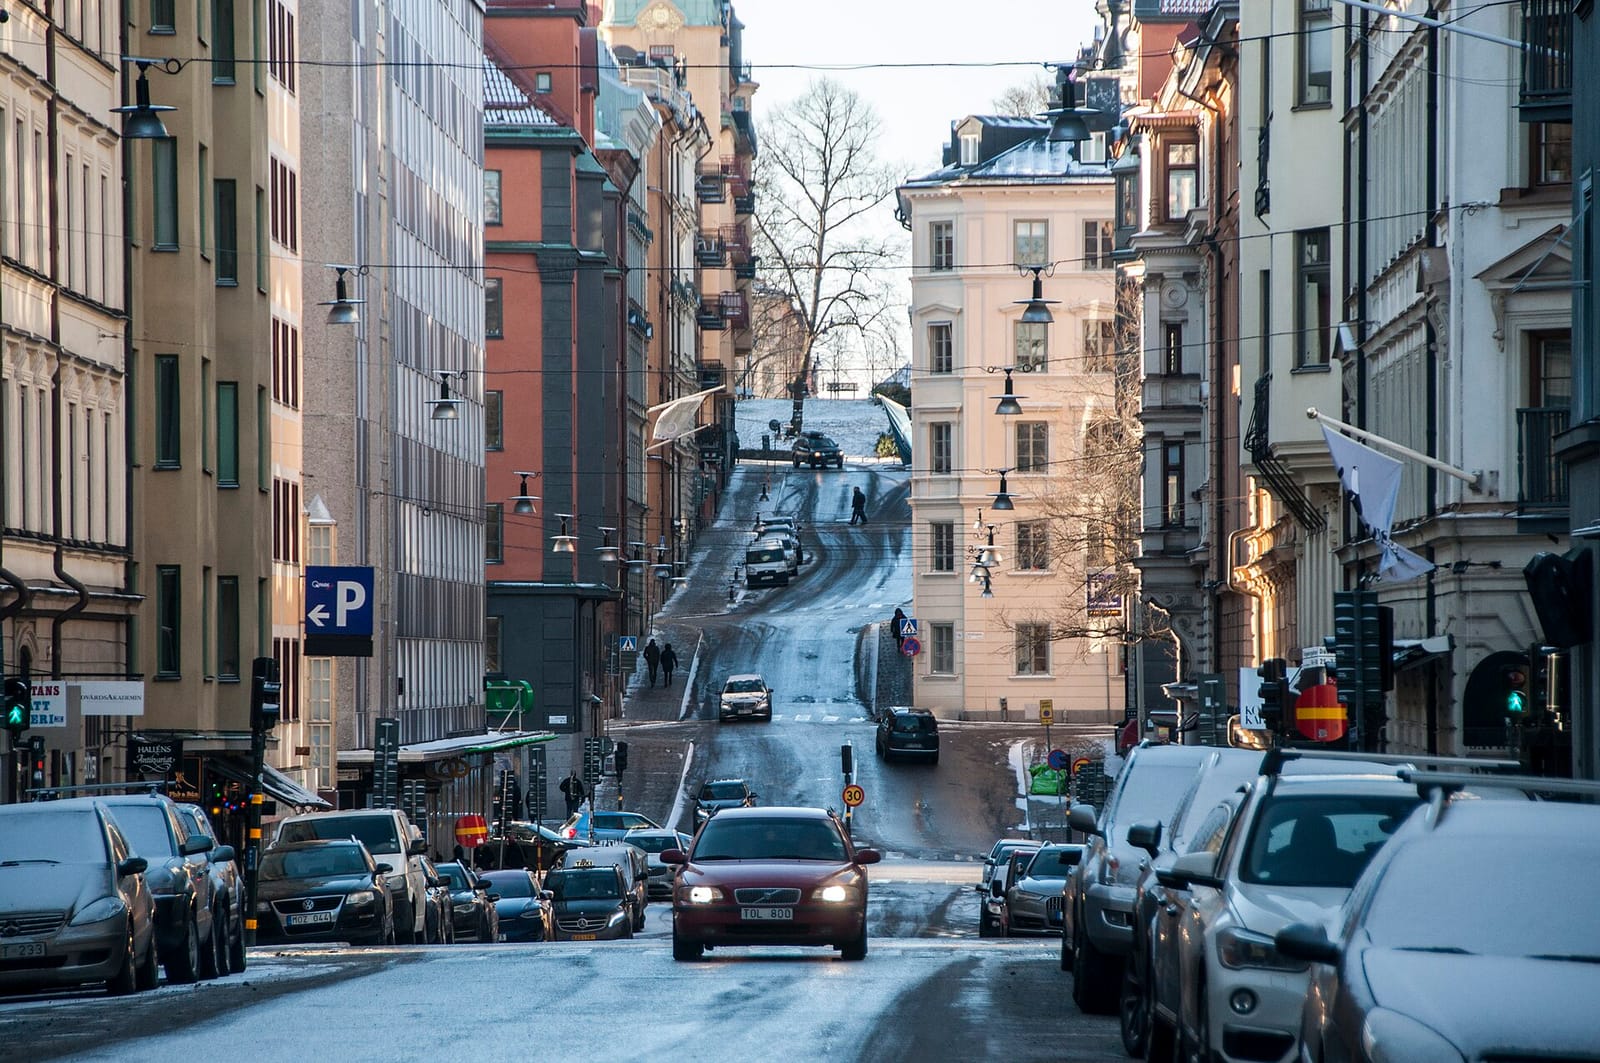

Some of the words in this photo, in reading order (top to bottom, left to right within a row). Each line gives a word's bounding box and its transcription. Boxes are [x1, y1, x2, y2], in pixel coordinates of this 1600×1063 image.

[336, 580, 366, 627] P
[31, 686, 60, 696] TANS
[846, 790, 862, 801] 30
[292, 915, 308, 924] MOZ
[313, 913, 329, 922] 044
[743, 908, 763, 919] TOL
[770, 908, 791, 919] 800
[18, 944, 42, 956] 233
